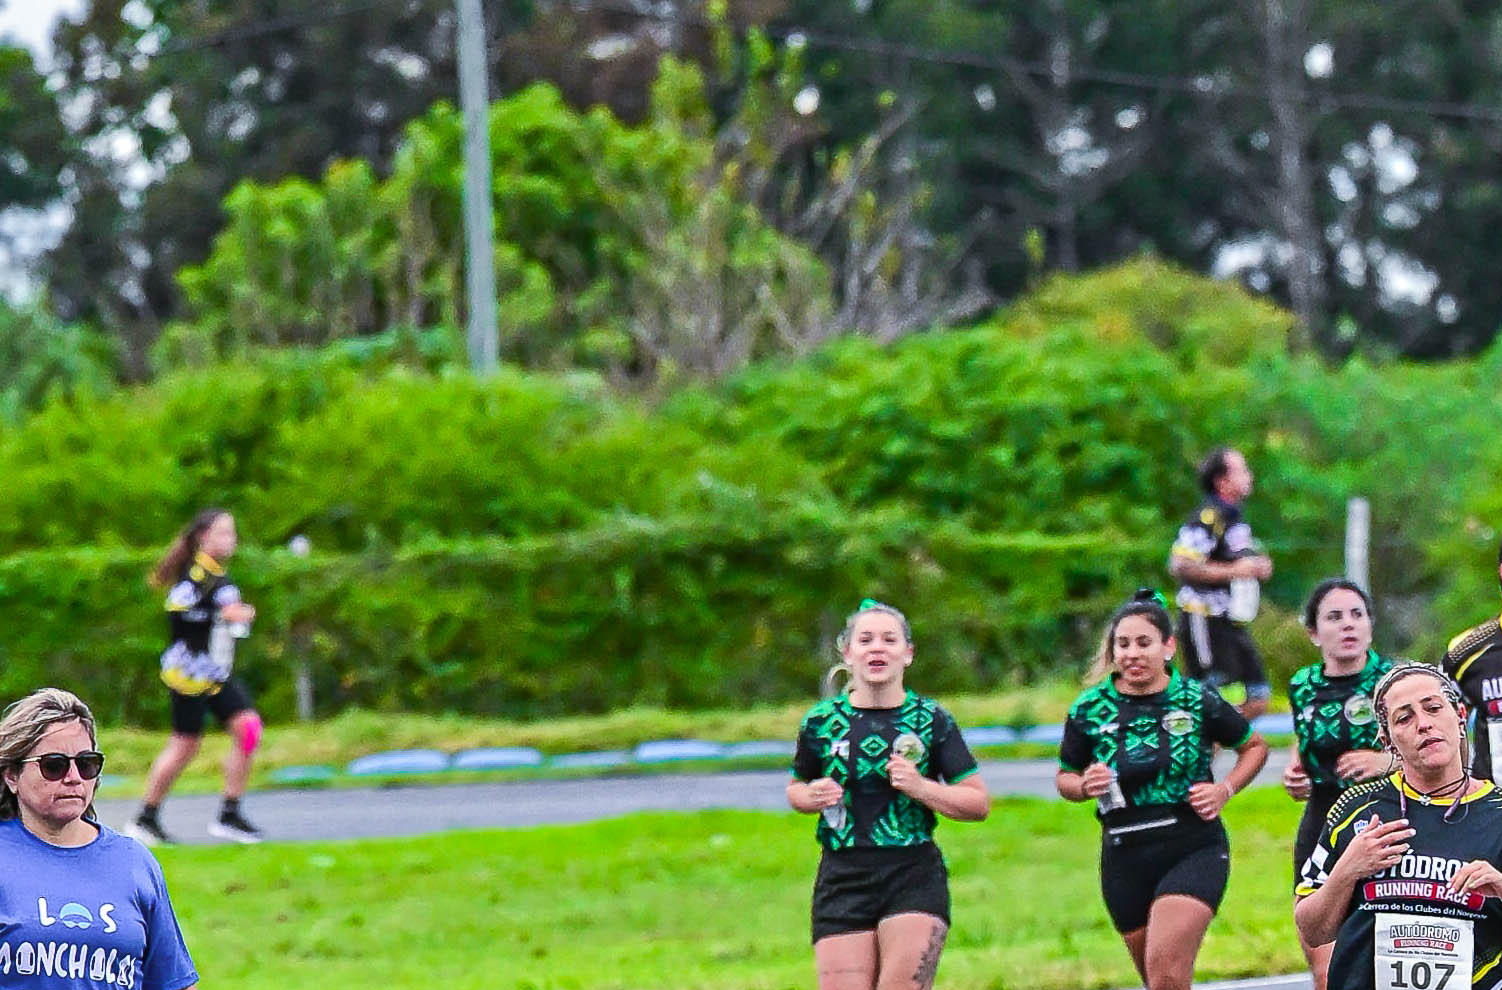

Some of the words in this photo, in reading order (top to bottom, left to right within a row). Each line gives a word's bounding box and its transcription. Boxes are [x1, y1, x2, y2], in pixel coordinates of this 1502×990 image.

[1375, 882, 1433, 898] RUNNING
[1435, 885, 1472, 906] RACE
[1390, 903, 1400, 911] de
[1402, 903, 1414, 912] los
[1415, 904, 1442, 914] Clubes
[1443, 907, 1455, 916] del
[1390, 921, 1460, 942] AUTÓDROMO
[1390, 961, 1456, 990] 107
